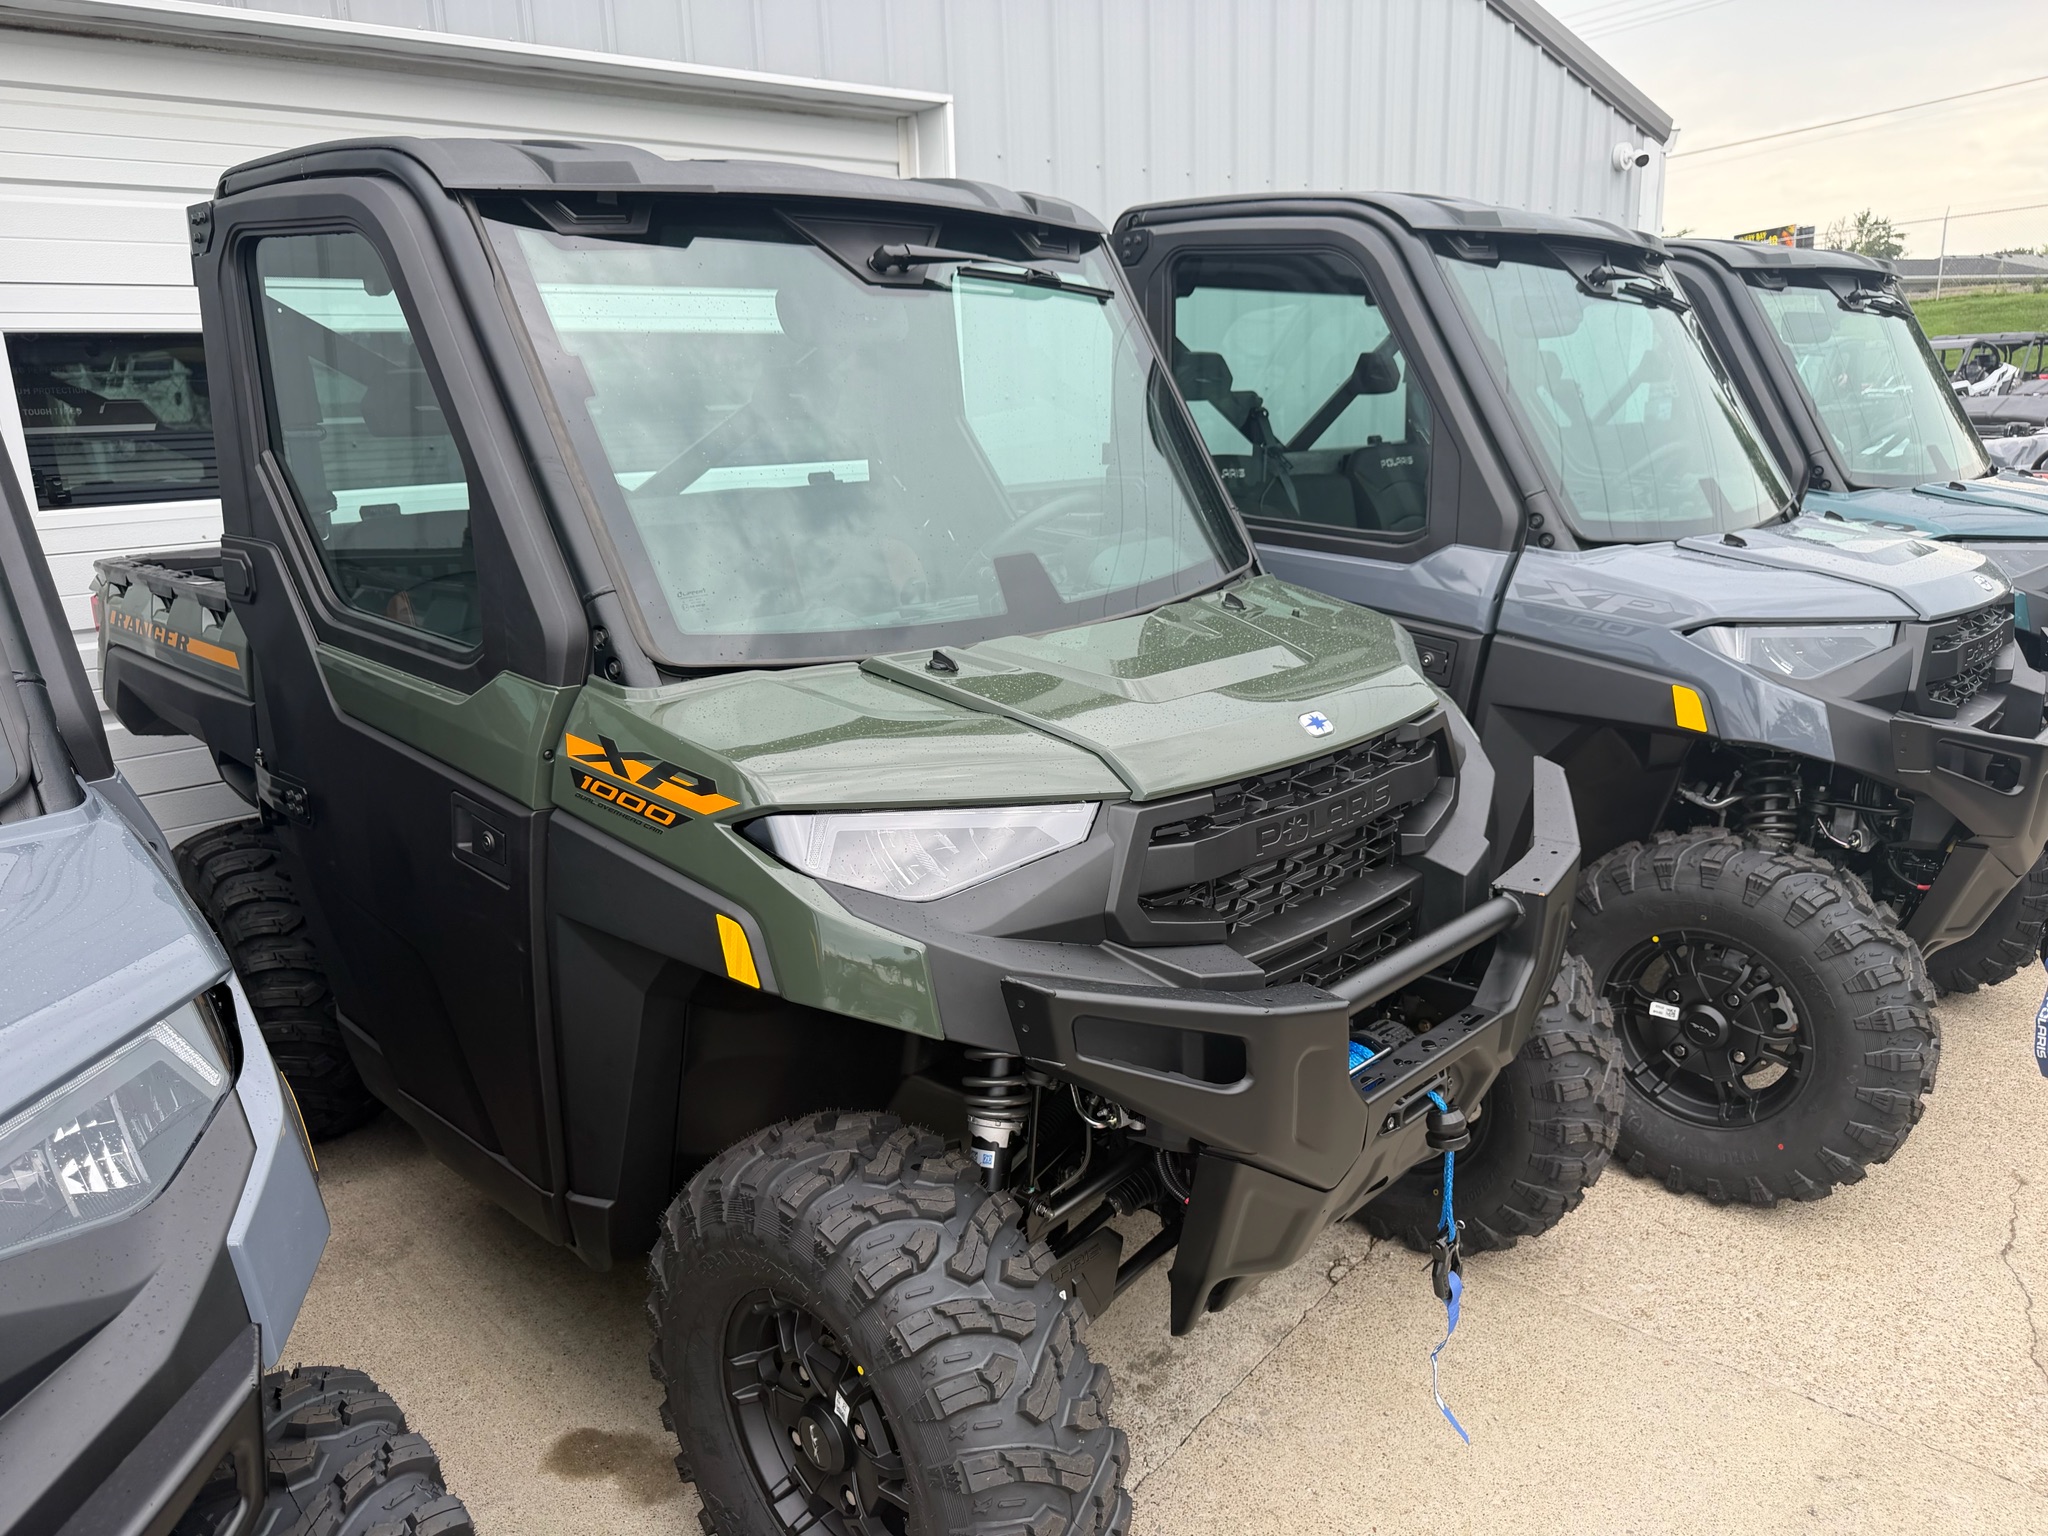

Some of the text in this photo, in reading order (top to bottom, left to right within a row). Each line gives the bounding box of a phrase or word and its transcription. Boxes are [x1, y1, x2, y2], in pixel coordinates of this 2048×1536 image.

[22, 407, 52, 416] TOUGH
[1521, 579, 1676, 615] XP
[114, 611, 190, 653] RANGER
[572, 733, 719, 797] XP
[580, 775, 677, 826] 1000
[1256, 780, 1392, 857] POLARIS
[643, 822, 664, 836] CAM
[1050, 1242, 1103, 1284] LARIS
